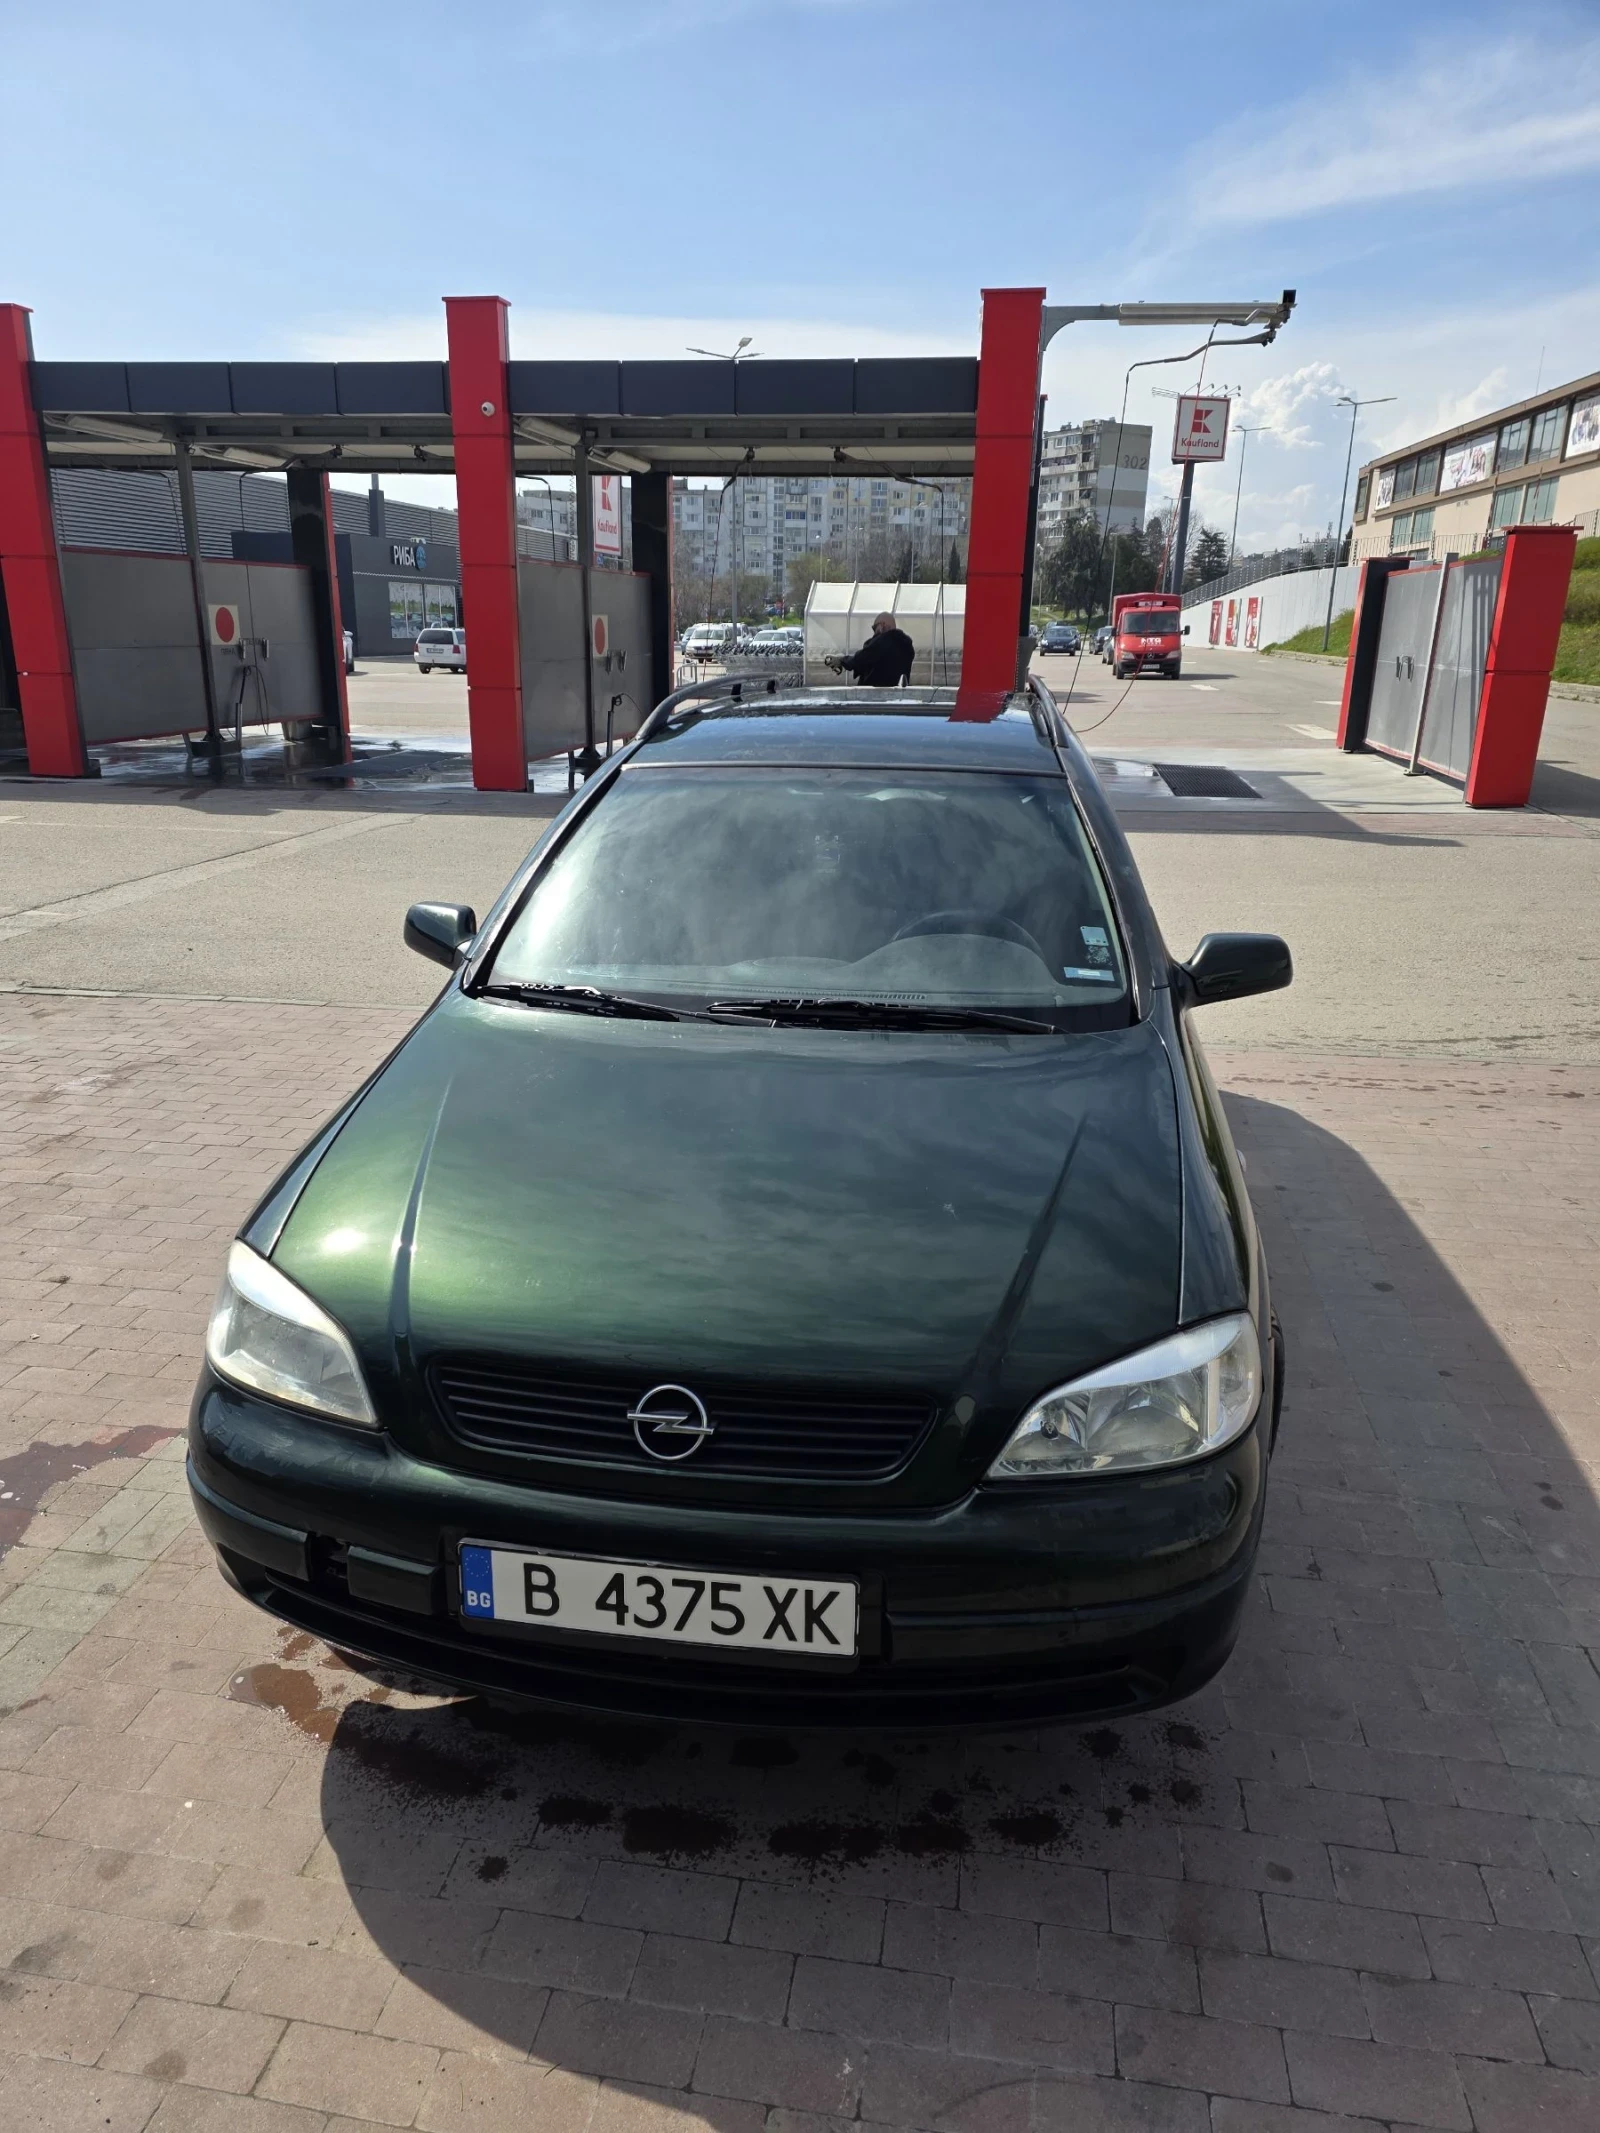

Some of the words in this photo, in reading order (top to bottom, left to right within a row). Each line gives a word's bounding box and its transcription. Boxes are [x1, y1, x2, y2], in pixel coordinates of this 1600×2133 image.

[1181, 438, 1220, 448] Kaufland
[1123, 454, 1148, 470] 302
[597, 519, 618, 535] Kaufland
[393, 545, 416, 567] РИБА
[466, 1590, 491, 1608] BG
[523, 1562, 560, 1616] B
[595, 1572, 745, 1635] 4375
[762, 1585, 841, 1645] XK
